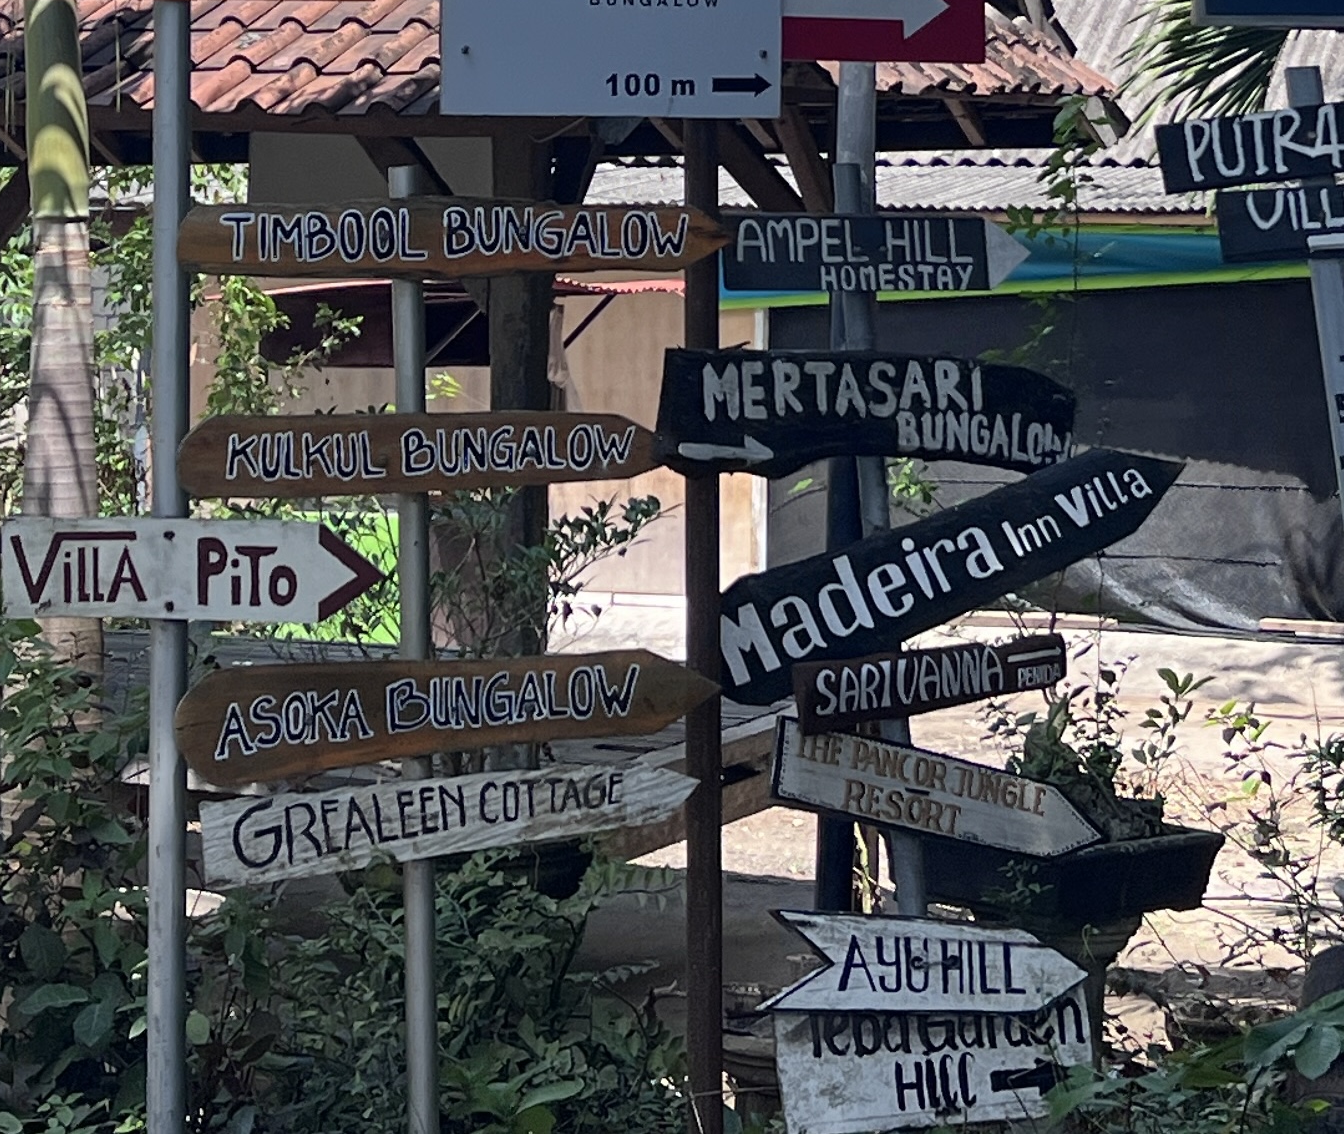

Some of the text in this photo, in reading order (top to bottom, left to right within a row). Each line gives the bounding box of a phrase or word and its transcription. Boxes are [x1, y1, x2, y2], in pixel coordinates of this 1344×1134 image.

[605, 73, 696, 97] 100 m
[220, 206, 689, 264] TIMBOOL BUNGALOW
[737, 217, 973, 265] AMPEL HILL
[820, 264, 973, 291] HOMESTAY
[225, 425, 636, 481] KULKUL BUNGALOW
[720, 526, 1004, 687] Madeira
[1055, 467, 1153, 528] Villa
[214, 664, 640, 761] ASOKA BUNGALOW
[232, 771, 624, 868] GREALEEN COTTAGE
[842, 779, 962, 835] RESORT
[952, 766, 1047, 817] JUNGLE
[838, 935, 1027, 995] AYU HILL
